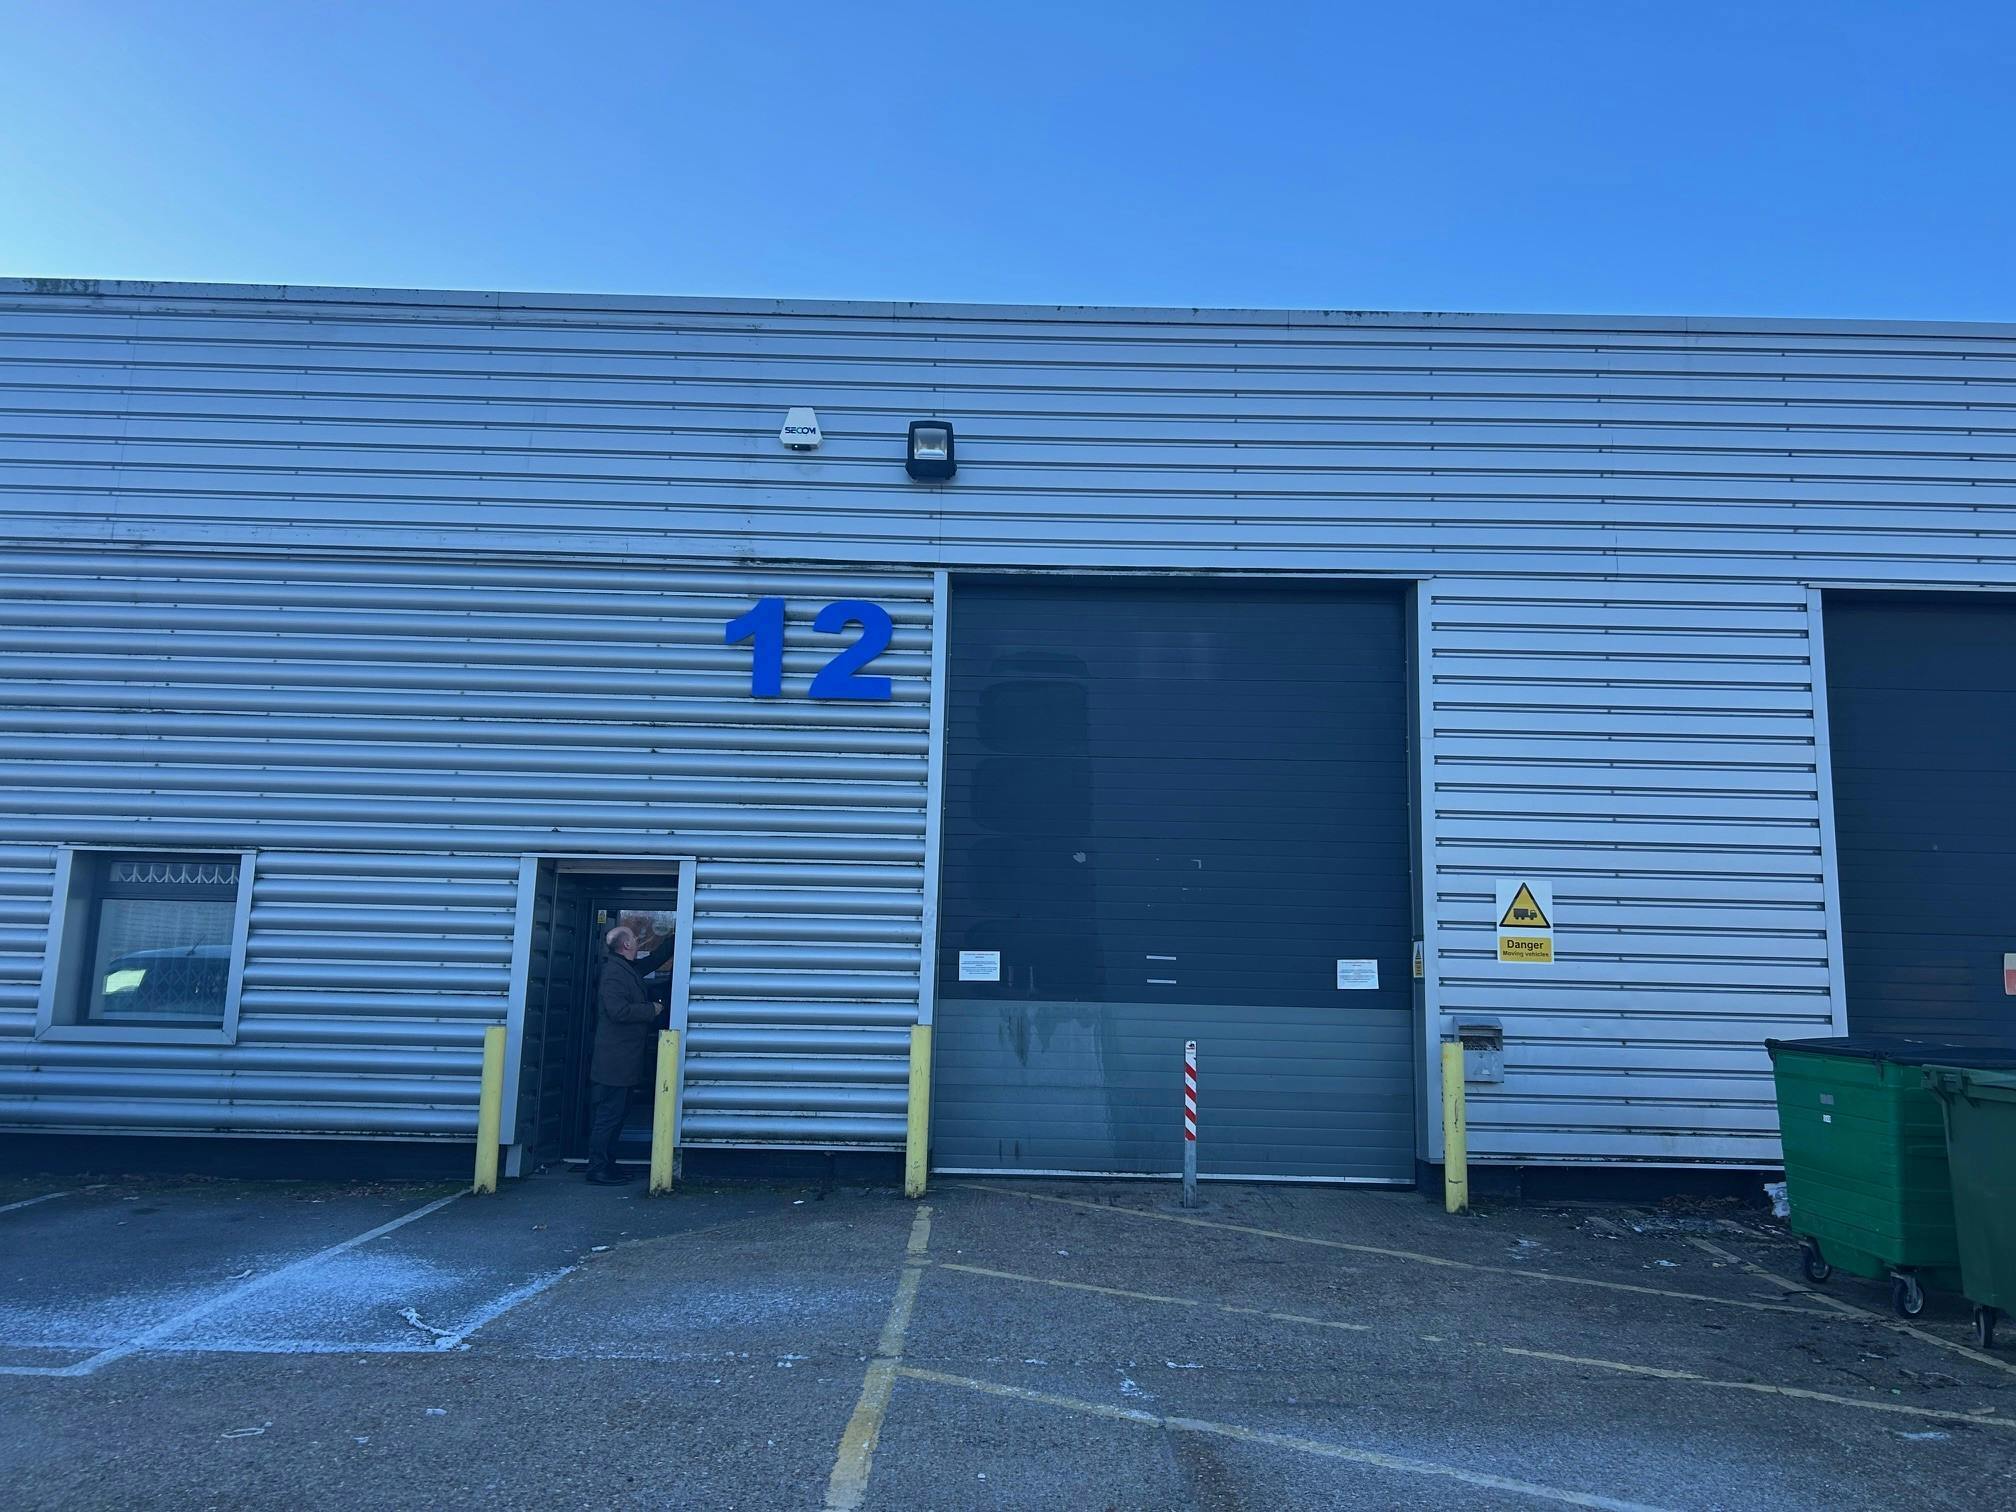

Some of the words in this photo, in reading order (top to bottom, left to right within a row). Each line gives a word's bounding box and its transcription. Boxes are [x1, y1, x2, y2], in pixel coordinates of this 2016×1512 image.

[785, 426, 816, 435] SECOM
[724, 597, 893, 699] 12
[1507, 939, 1544, 951] Danger
